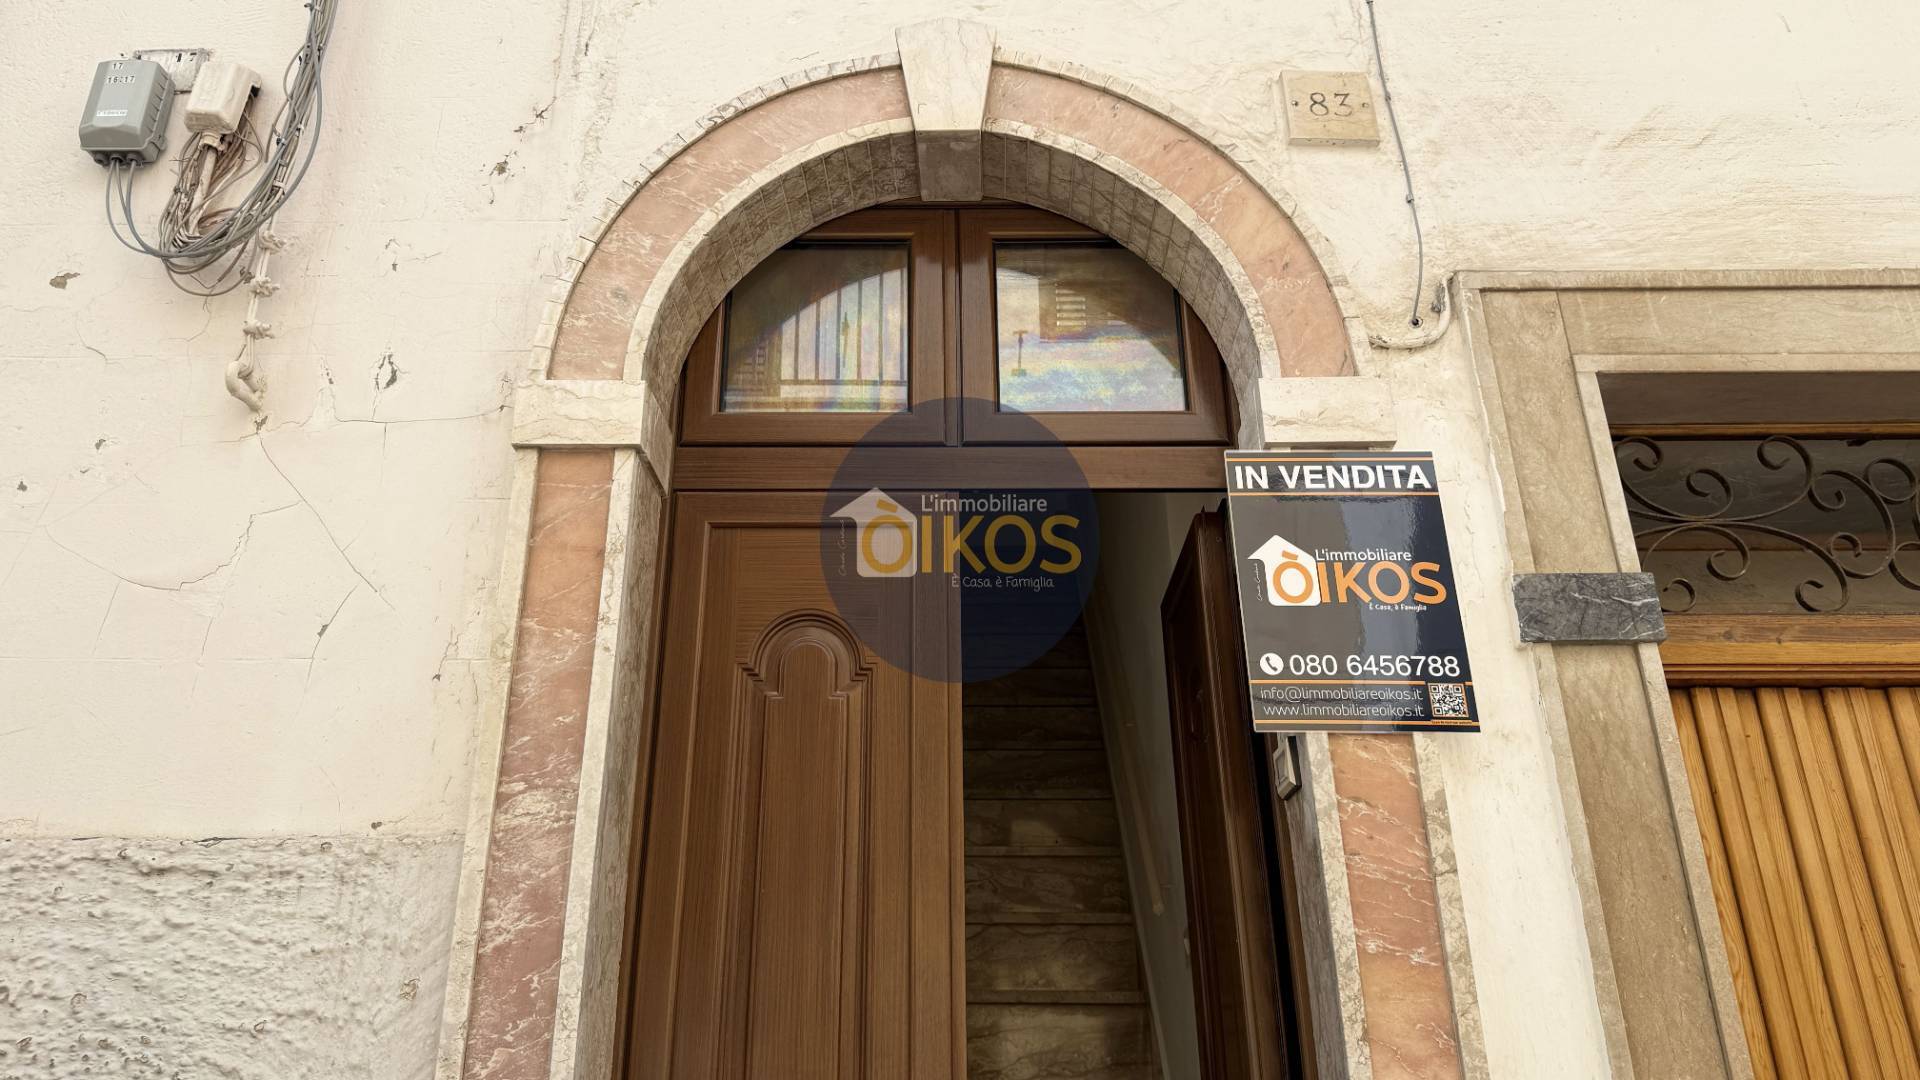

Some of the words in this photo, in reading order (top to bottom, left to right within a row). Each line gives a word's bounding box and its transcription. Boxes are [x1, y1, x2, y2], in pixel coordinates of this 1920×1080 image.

[1309, 92, 1353, 117] 83
[1235, 465, 1269, 489] IN
[1278, 464, 1432, 489] VENDITA
[1315, 548, 1412, 561] L'immobiliare
[1289, 654, 1338, 676] 080
[1346, 655, 1461, 677] 6456788
[1260, 686, 1424, 702] info@limmobiliareoikos.it
[1263, 704, 1425, 717] www.limmobiliareoikos.it
